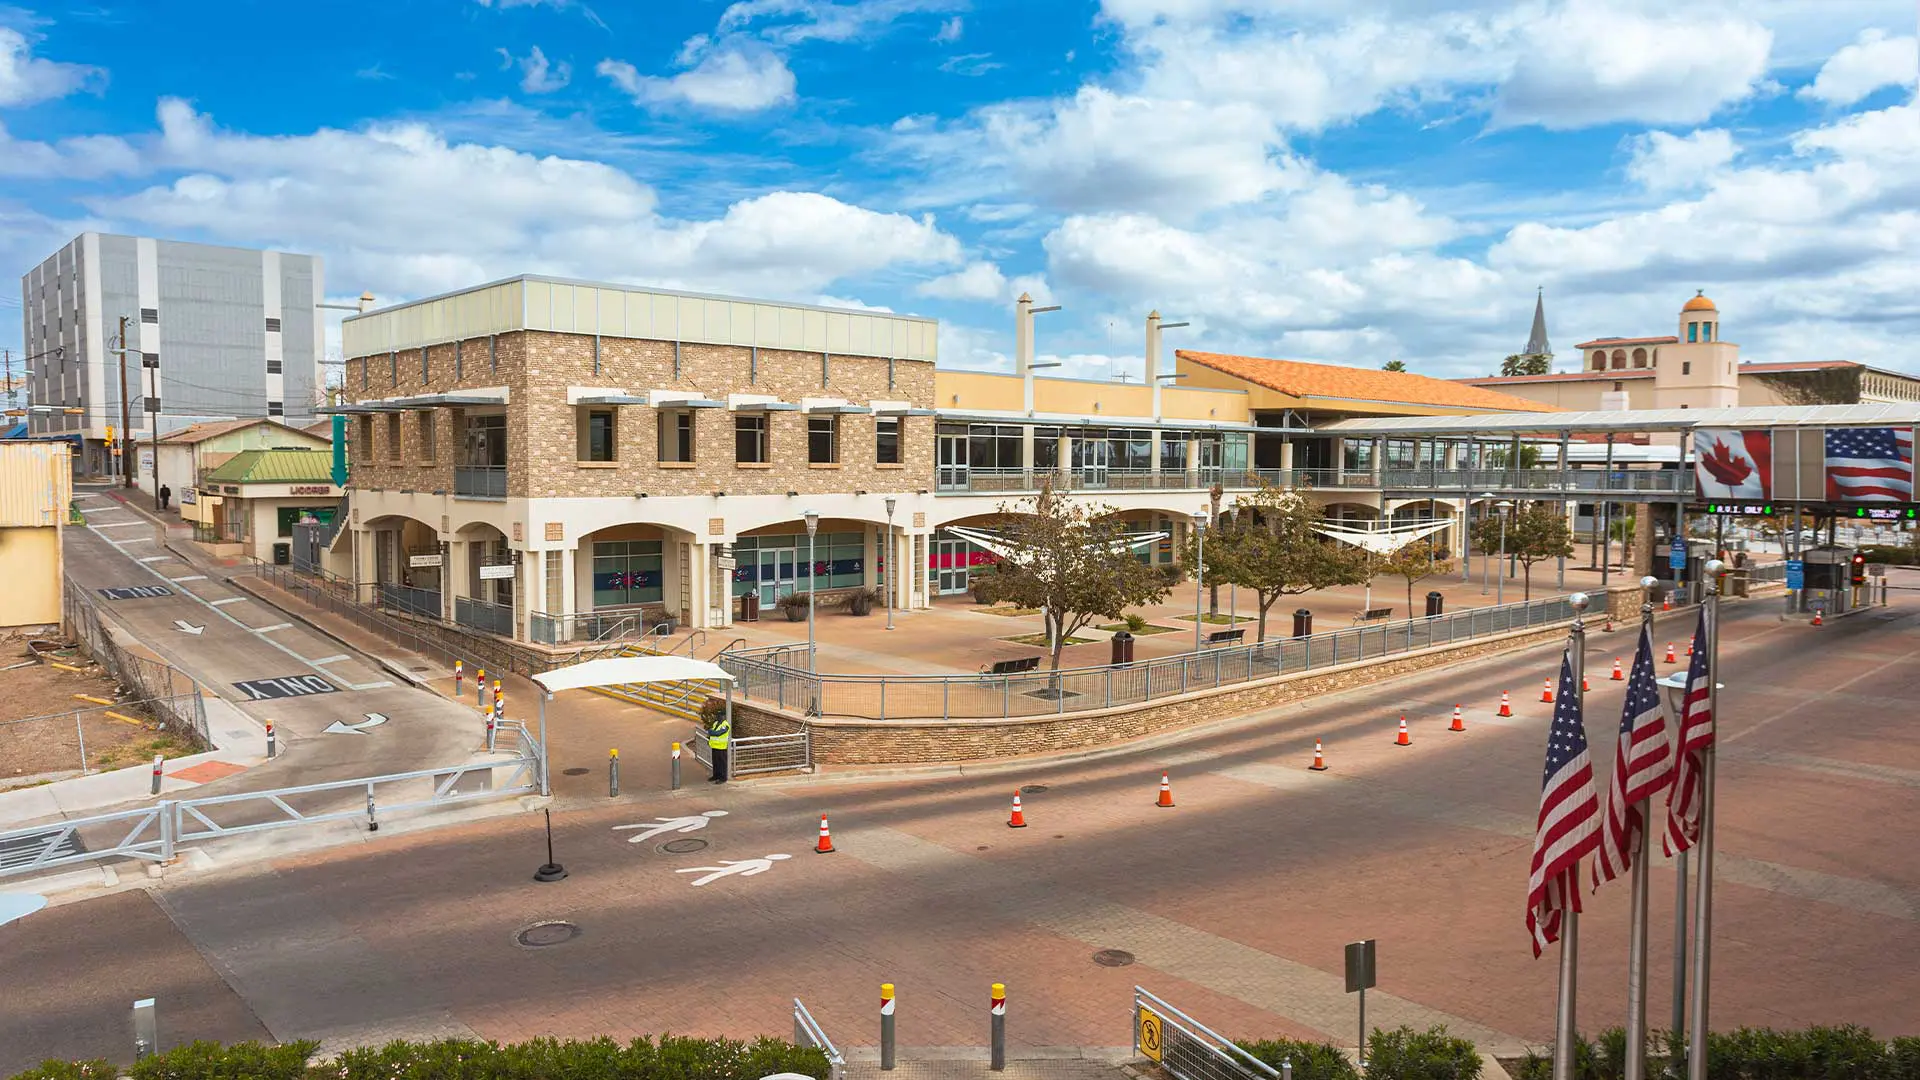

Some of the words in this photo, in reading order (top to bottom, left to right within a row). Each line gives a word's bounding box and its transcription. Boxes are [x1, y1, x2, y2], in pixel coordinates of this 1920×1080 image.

[289, 485, 330, 495] LICORES
[1744, 506, 1763, 514] ONLY
[103, 586, 172, 600] ONLY
[241, 675, 334, 699] ONLY
